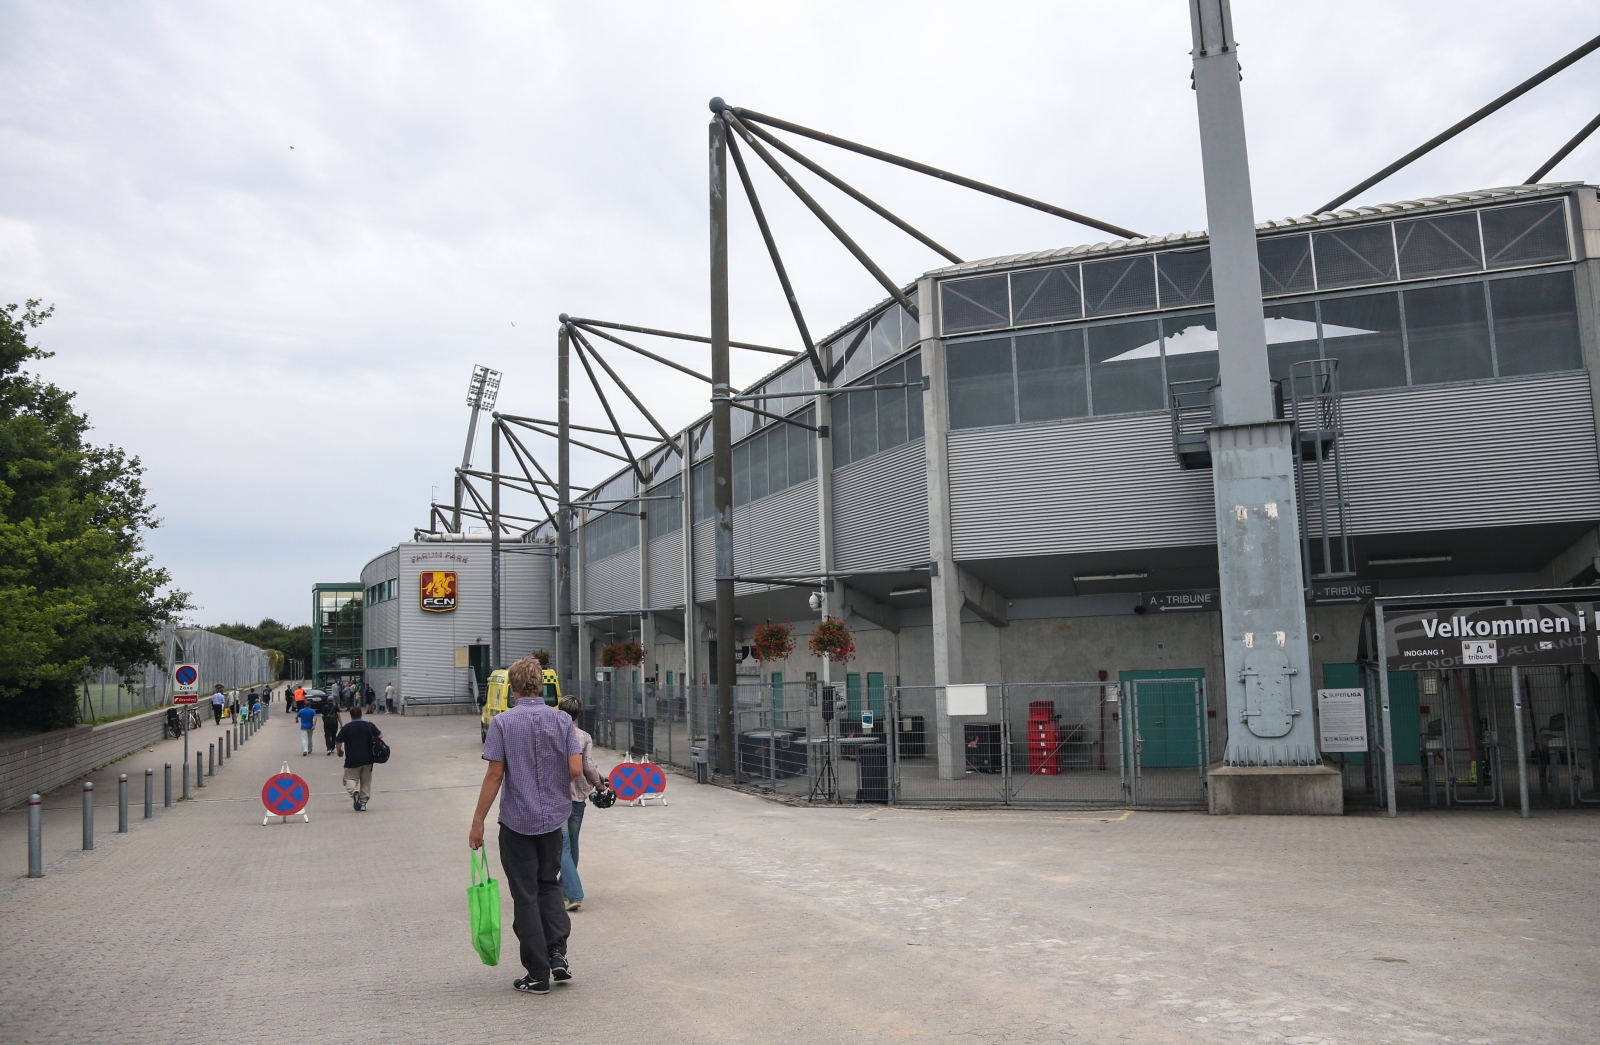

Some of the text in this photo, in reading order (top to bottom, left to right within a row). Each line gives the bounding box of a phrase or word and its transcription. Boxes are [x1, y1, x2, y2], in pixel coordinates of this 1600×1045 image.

[411, 552, 468, 563] FARUM PARK
[1324, 585, 1372, 596] TRIBUNE
[1150, 596, 1158, 605] A
[1166, 593, 1211, 604] TRIBUNE
[1421, 615, 1570, 638] Velkommen
[1579, 610, 1586, 632] i
[1404, 649, 1439, 657] INDGANG
[1476, 645, 1484, 654] A
